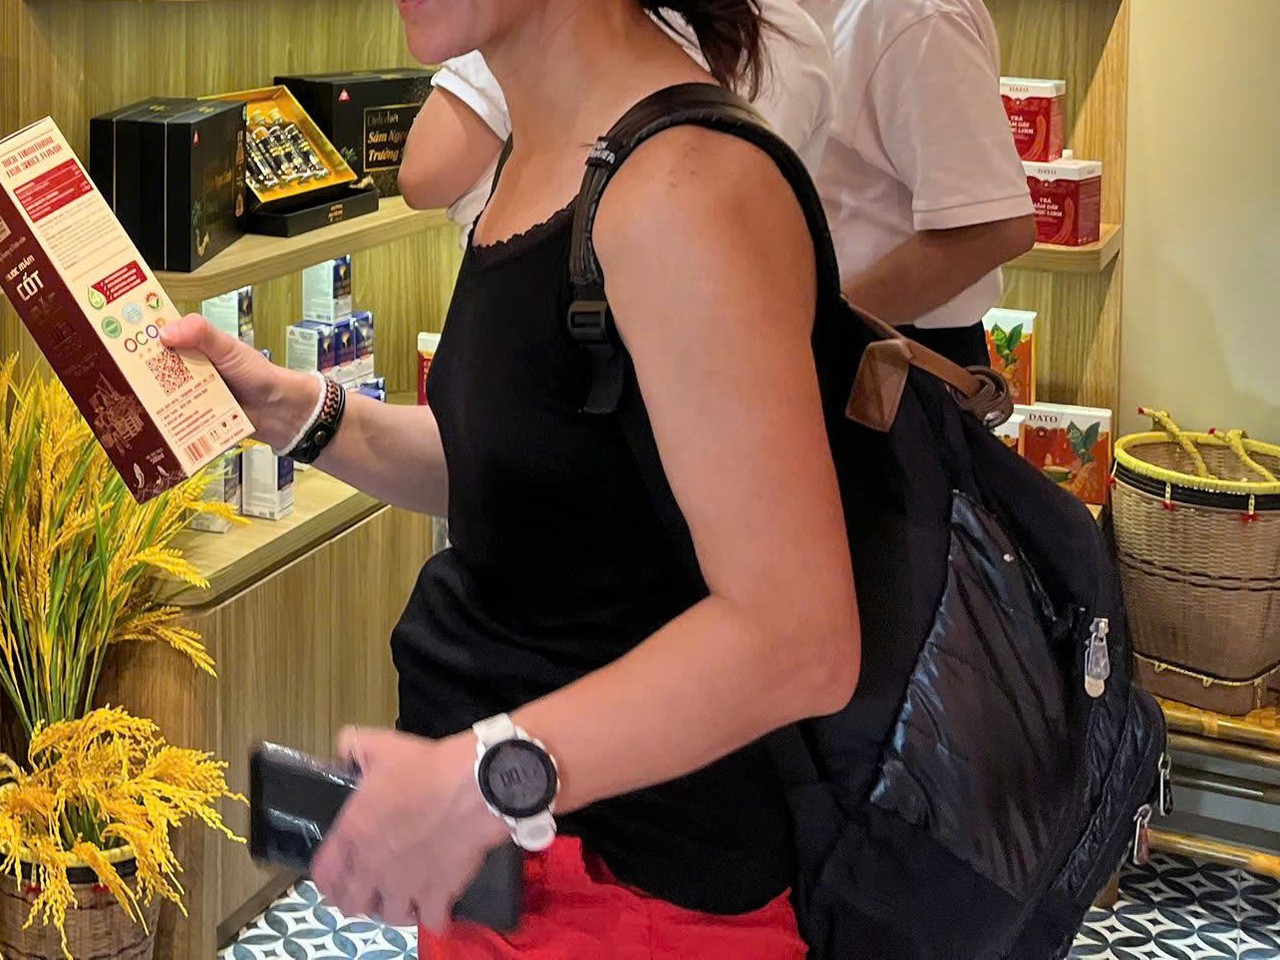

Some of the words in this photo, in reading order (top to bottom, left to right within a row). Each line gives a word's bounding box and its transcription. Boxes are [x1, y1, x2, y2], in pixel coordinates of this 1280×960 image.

[367, 130, 388, 145] Sâm
[16, 270, 45, 301] CỐT
[1029, 413, 1058, 423] DATO
